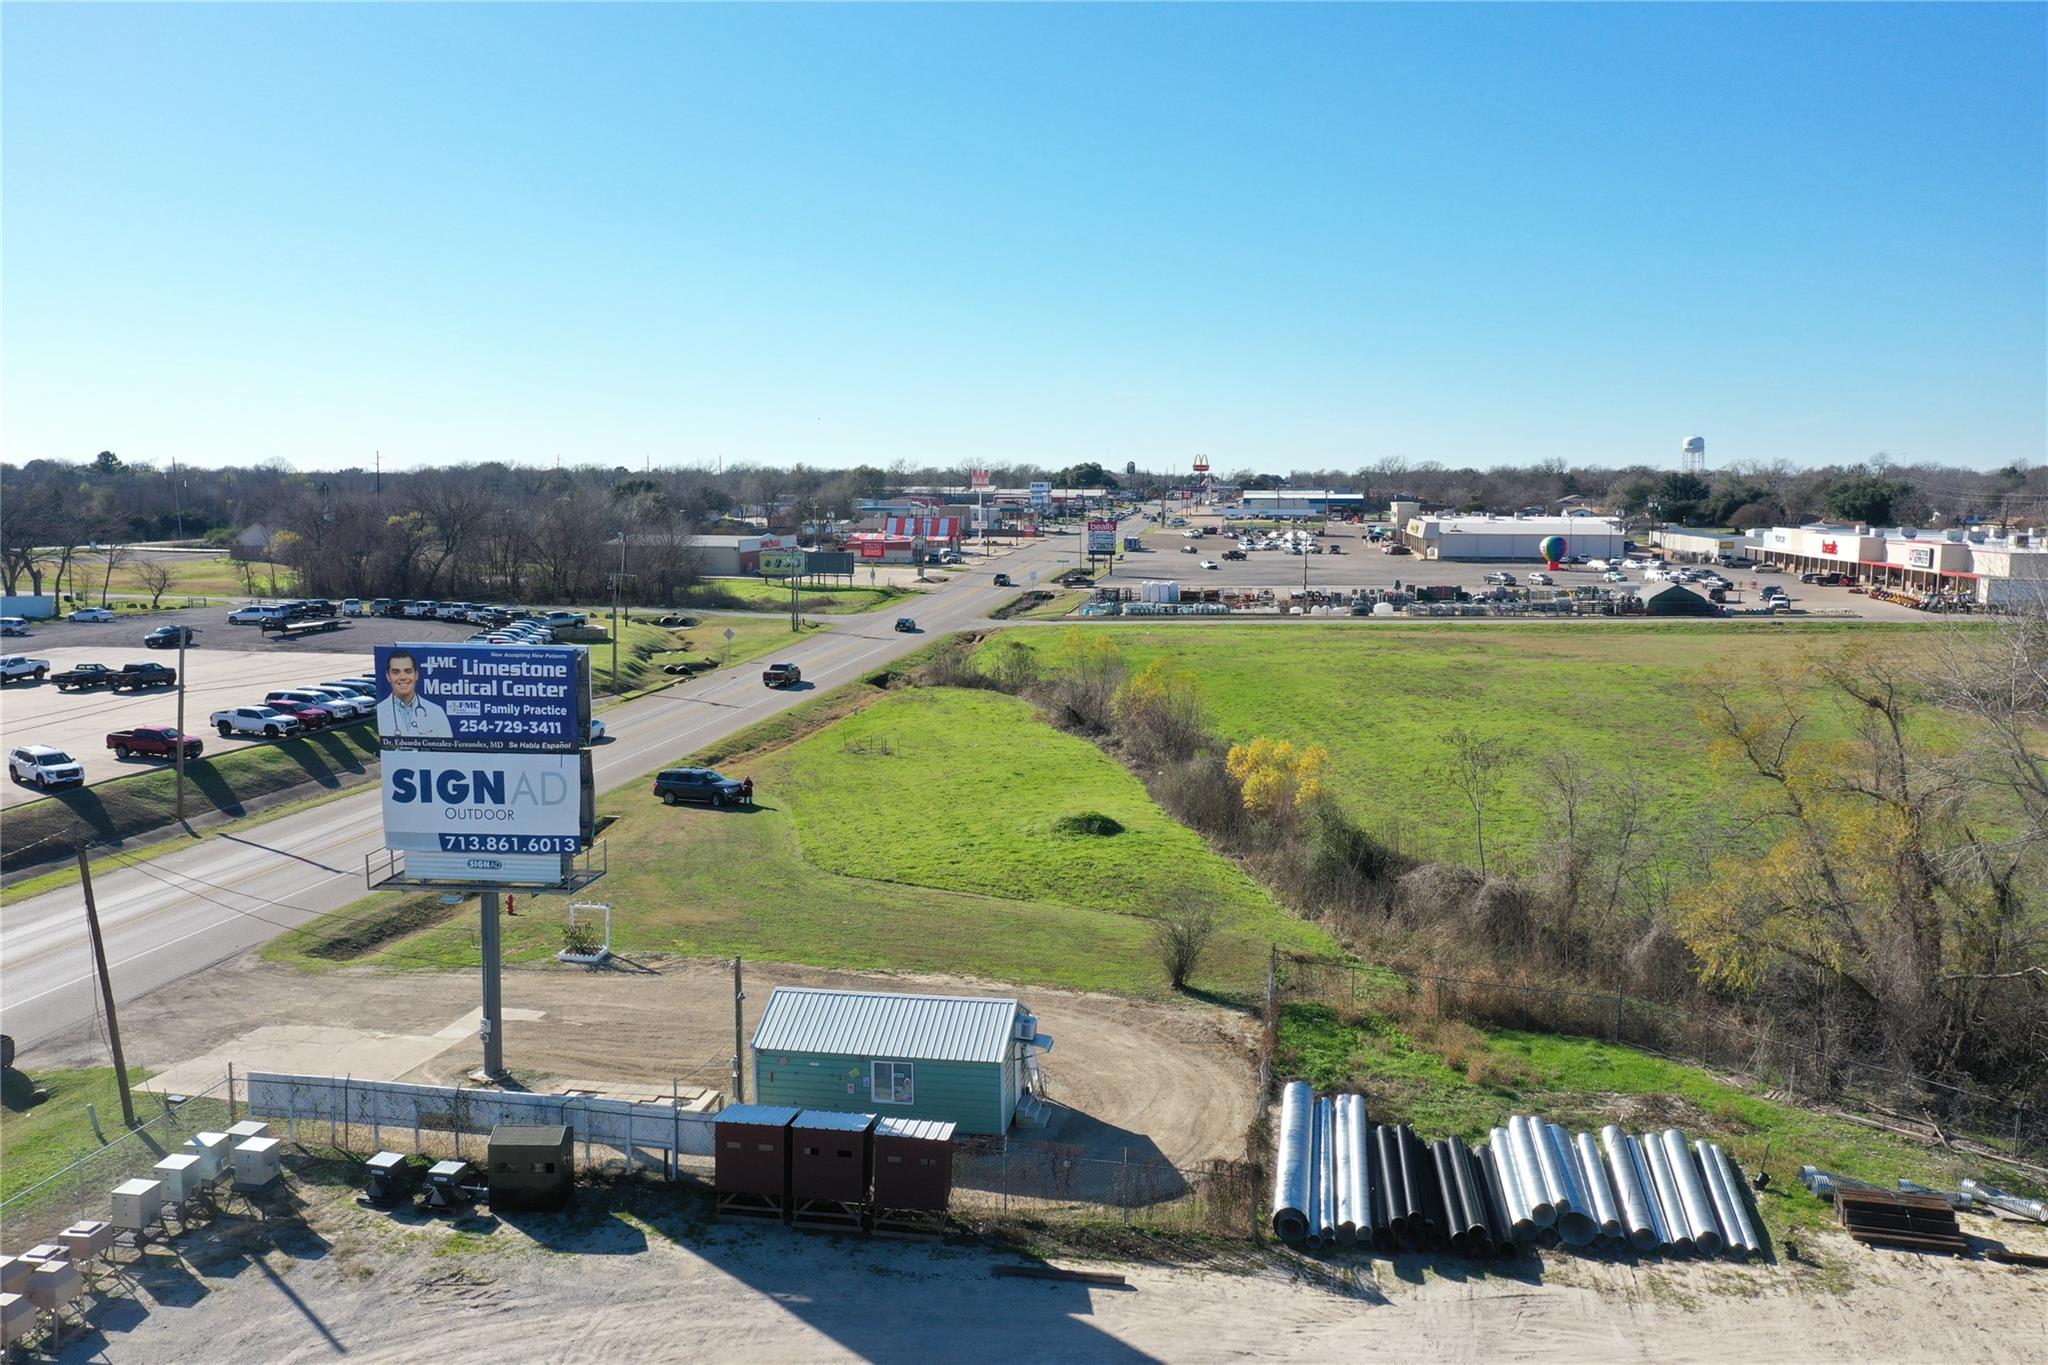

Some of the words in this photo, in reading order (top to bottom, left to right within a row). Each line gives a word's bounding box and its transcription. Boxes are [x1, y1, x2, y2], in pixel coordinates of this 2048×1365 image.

[1090, 522, 1114, 531] bealls
[462, 659, 567, 678] Limestone
[424, 678, 498, 696] Medical
[502, 680, 568, 698] Center
[484, 703, 520, 717] Family
[523, 704, 567, 716] Practice
[459, 720, 562, 735] 254-729-3411
[383, 738, 394, 746] Dr.
[394, 738, 421, 747] Eduardo
[489, 740, 504, 749] MD
[508, 741, 518, 749] Se
[519, 741, 540, 749] Habla
[541, 741, 571, 750] Español
[445, 836, 576, 852] 713.861.6013
